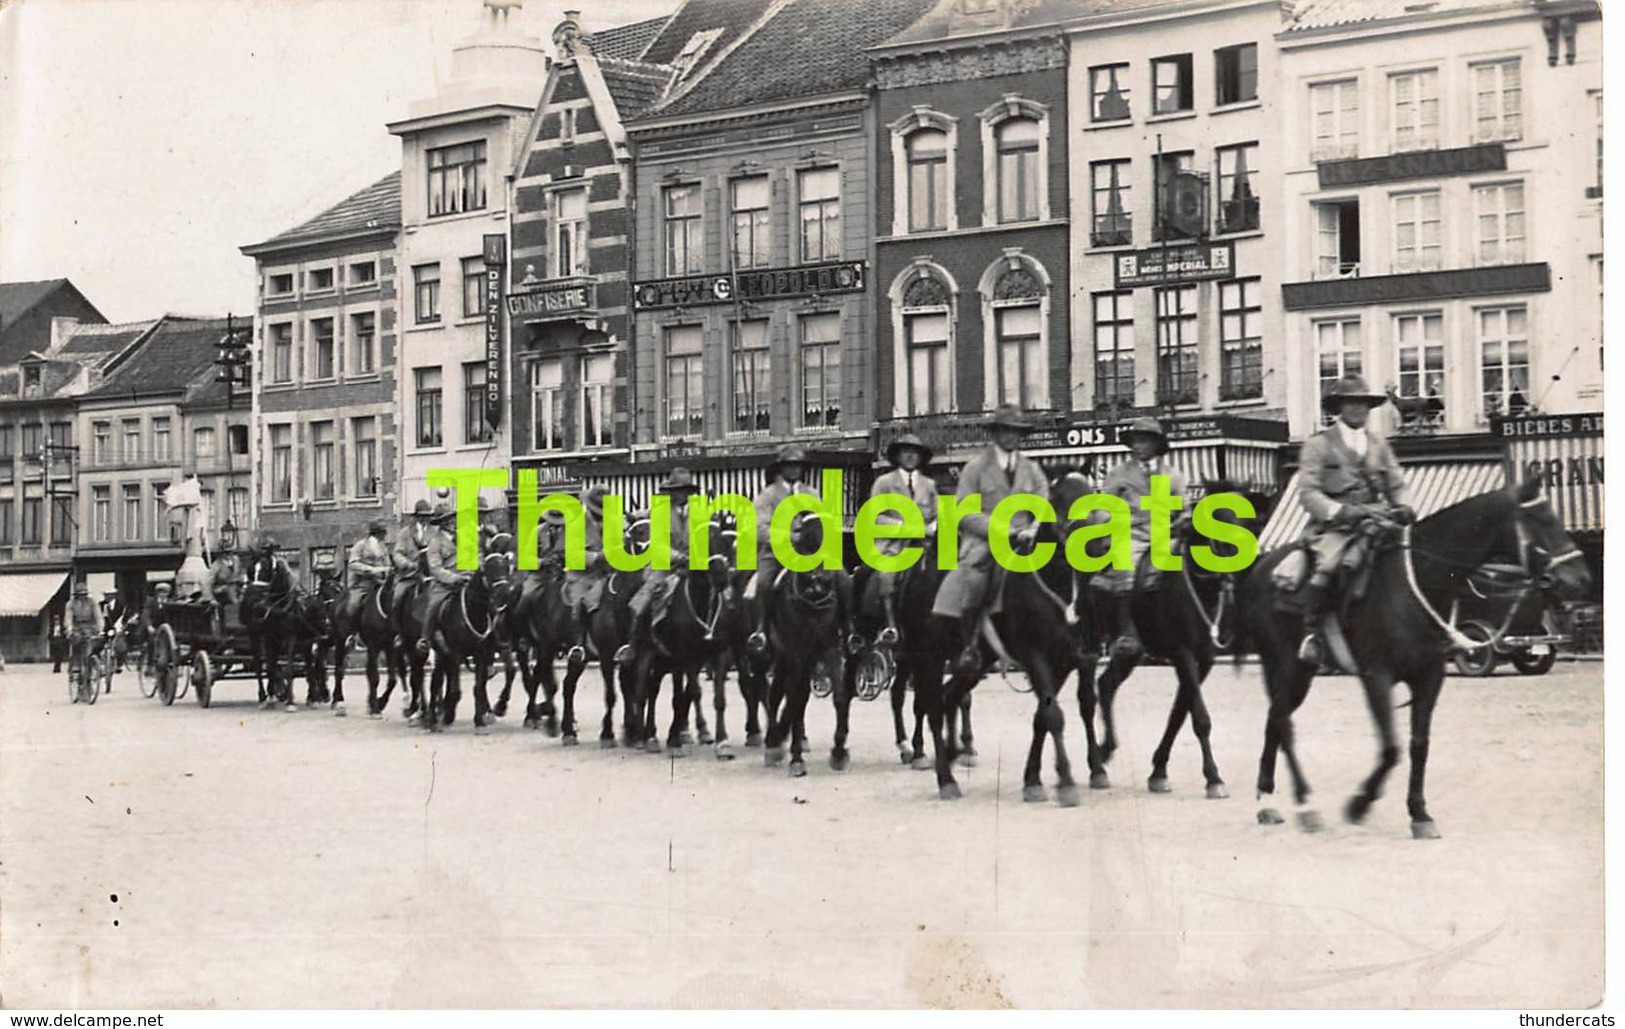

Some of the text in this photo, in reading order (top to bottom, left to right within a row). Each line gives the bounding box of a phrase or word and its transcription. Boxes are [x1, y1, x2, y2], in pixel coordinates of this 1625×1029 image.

[488, 271, 499, 300] DEN
[508, 288, 587, 316] CONFISERIE
[1067, 428, 1105, 445] ONS
[1503, 419, 1572, 436] BIERES
